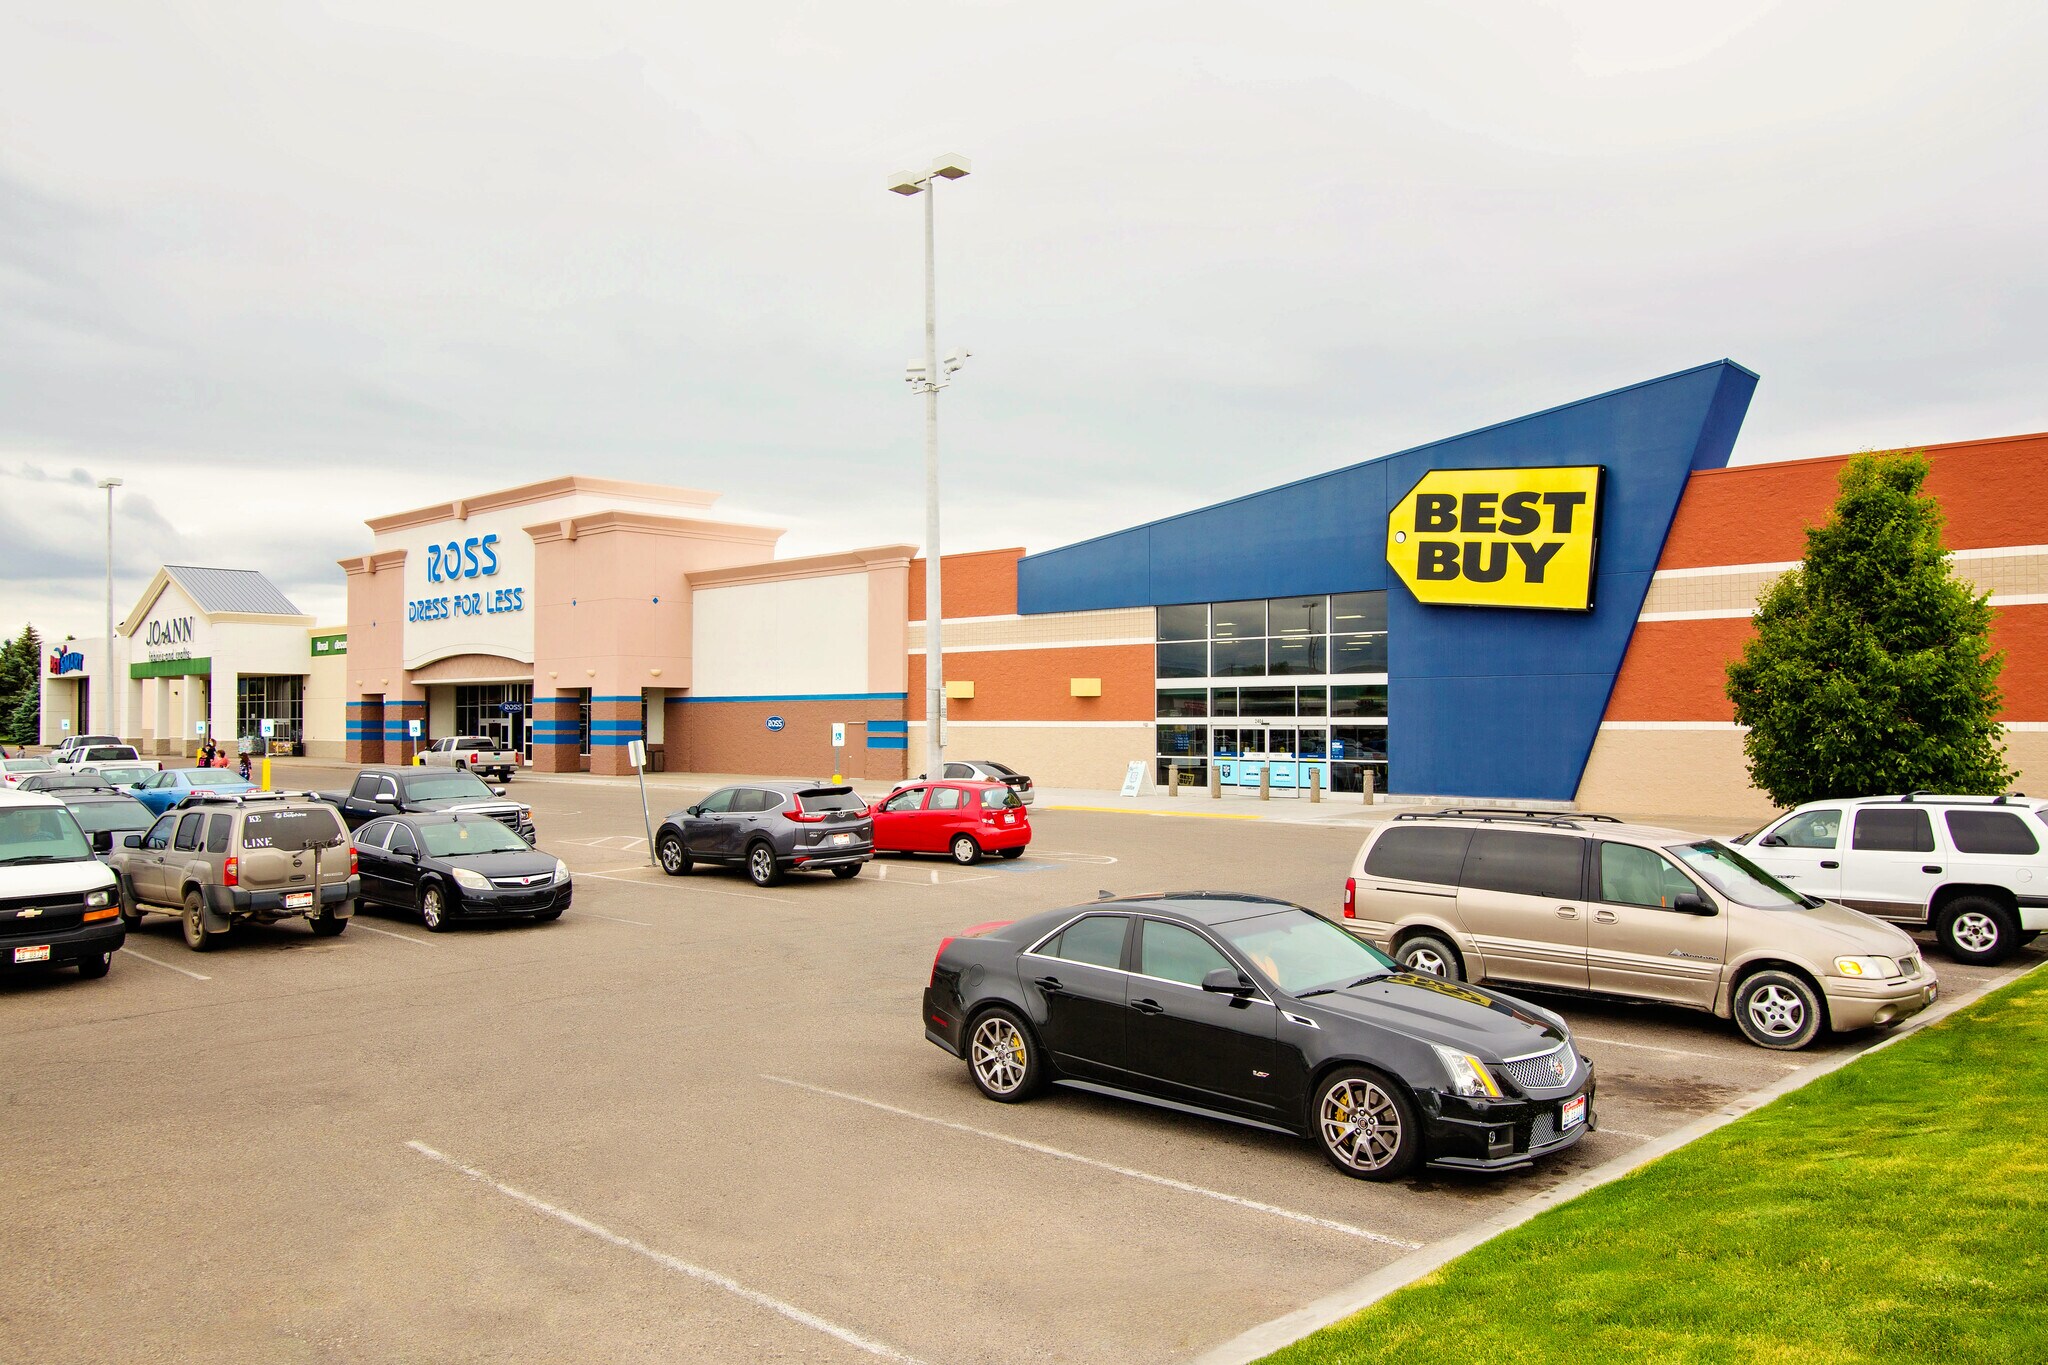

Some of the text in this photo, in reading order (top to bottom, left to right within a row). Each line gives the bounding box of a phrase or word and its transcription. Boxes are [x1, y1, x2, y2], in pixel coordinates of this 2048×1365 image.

[1414, 491, 1587, 536] BEST
[427, 533, 499, 583] ROSS
[1416, 541, 1565, 583] BUY
[408, 587, 524, 622] DRESS FOR LESS
[504, 703, 522, 711] ROSS
[767, 719, 783, 727] ROSS
